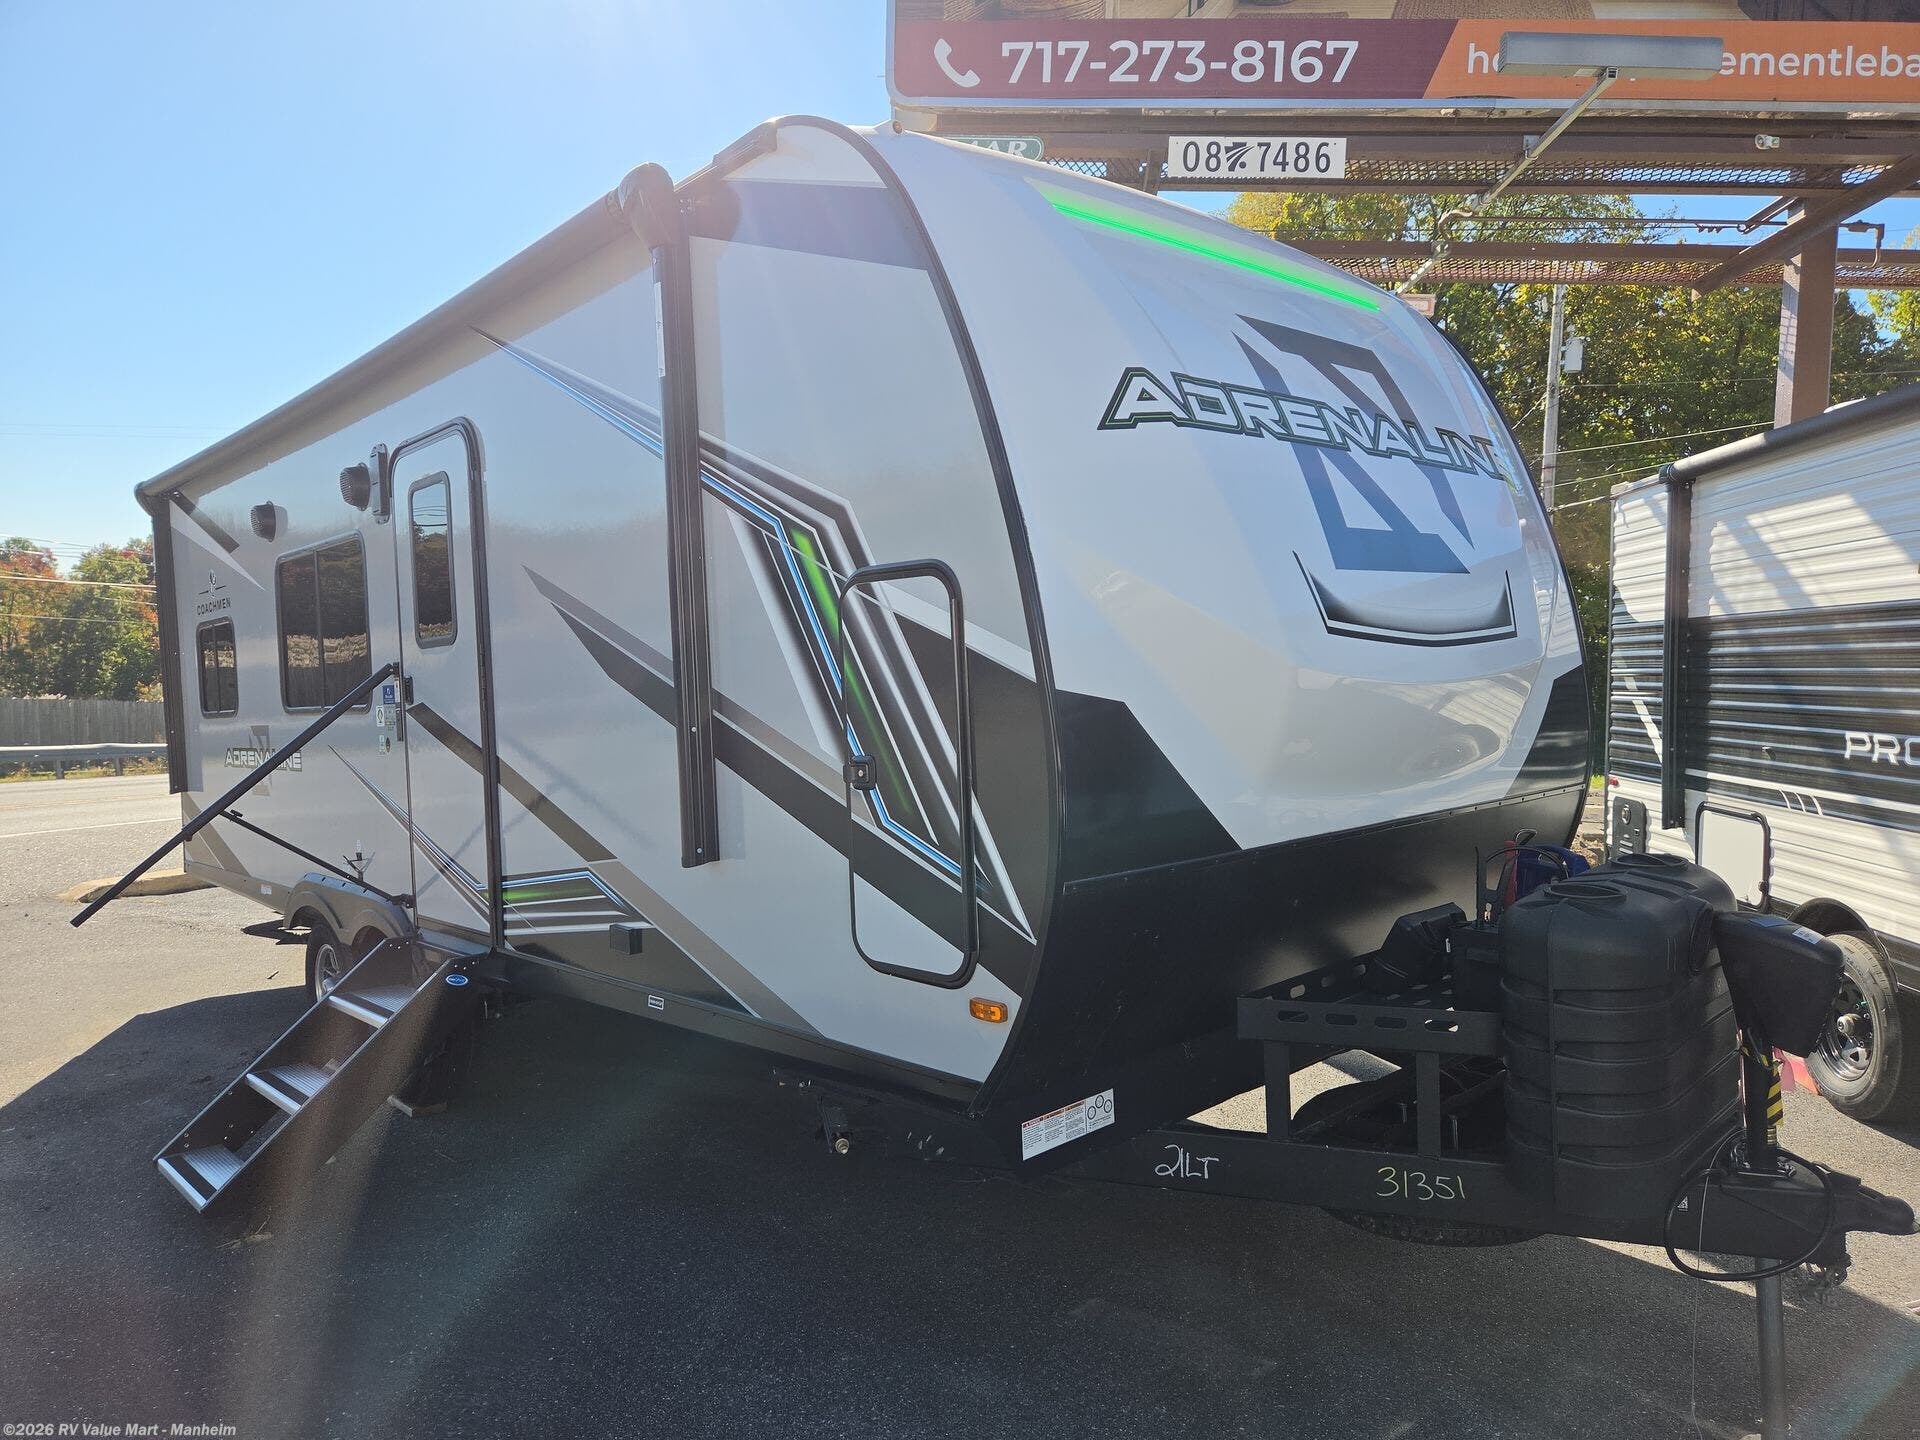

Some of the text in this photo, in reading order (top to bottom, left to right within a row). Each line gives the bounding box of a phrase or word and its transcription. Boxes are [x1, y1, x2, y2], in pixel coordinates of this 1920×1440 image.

[1002, 40, 1359, 83] 717-273-8167
[1183, 141, 1331, 174] 08 7486
[196, 597, 231, 616] COACHMEN
[1376, 1166, 1465, 1200] 31351
